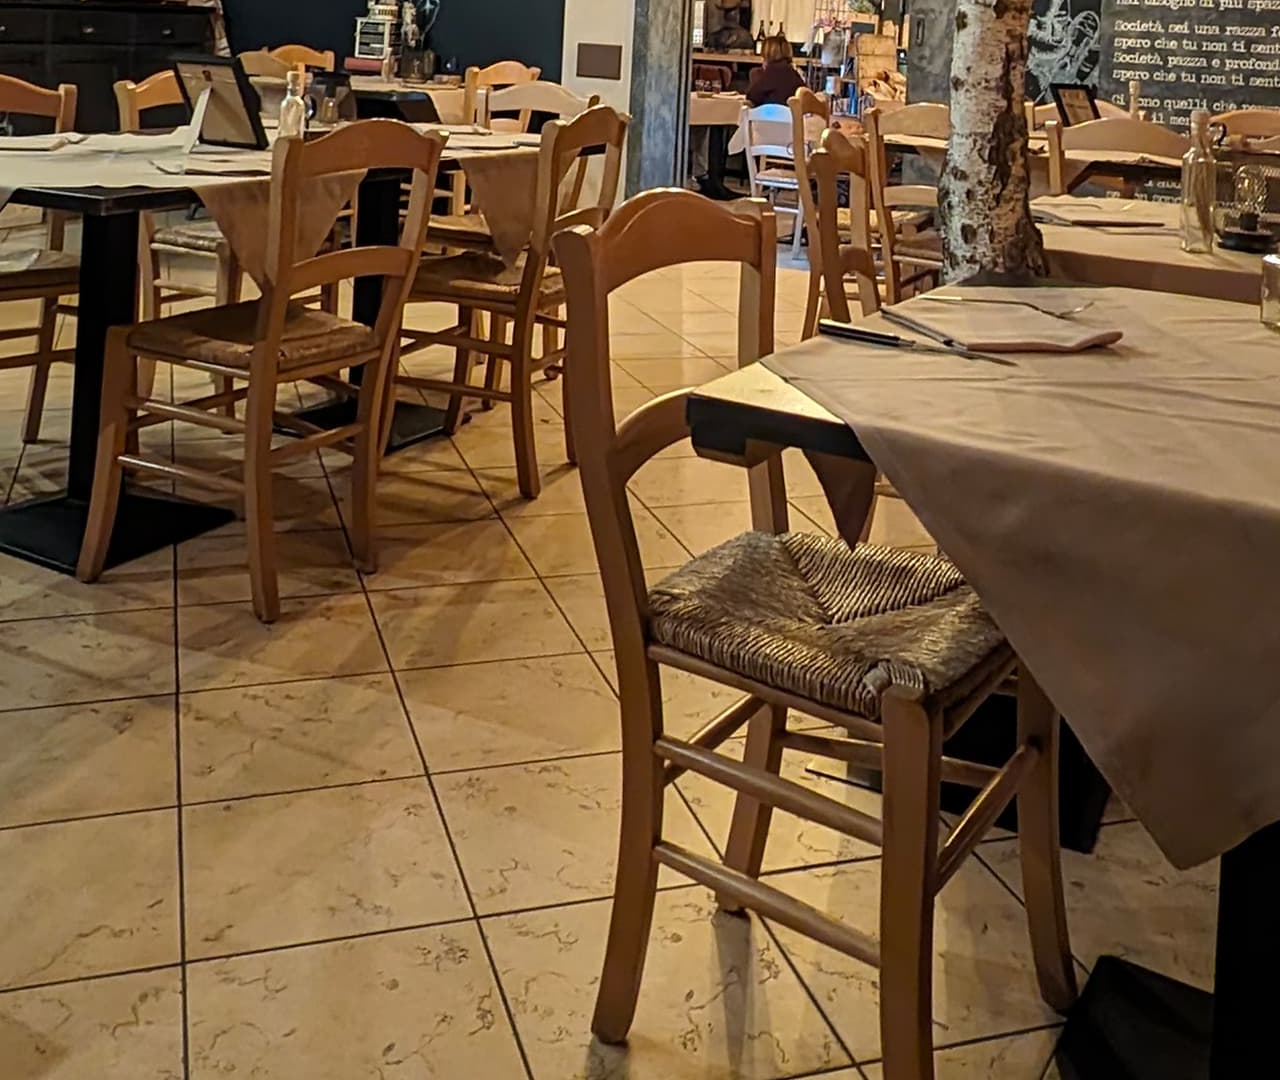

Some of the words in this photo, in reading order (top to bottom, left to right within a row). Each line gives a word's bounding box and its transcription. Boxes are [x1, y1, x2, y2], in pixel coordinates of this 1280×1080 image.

[1169, 22, 1189, 33] sei
[1195, 25, 1219, 34] una
[1225, 26, 1265, 36] razza
[1114, 37, 1151, 51] spero
[1155, 38, 1178, 49] che
[1182, 39, 1197, 50] tu
[1202, 42, 1227, 51] non
[1233, 41, 1246, 52] ti
[1168, 57, 1207, 69] pazza
[1212, 59, 1220, 67] e
[1113, 69, 1149, 83] spero
[1153, 71, 1176, 81] che
[1181, 72, 1196, 83] tu
[1201, 75, 1226, 84] non
[1231, 74, 1244, 85] ti
[1112, 94, 1126, 106] Ci
[1164, 98, 1208, 111] quelli
